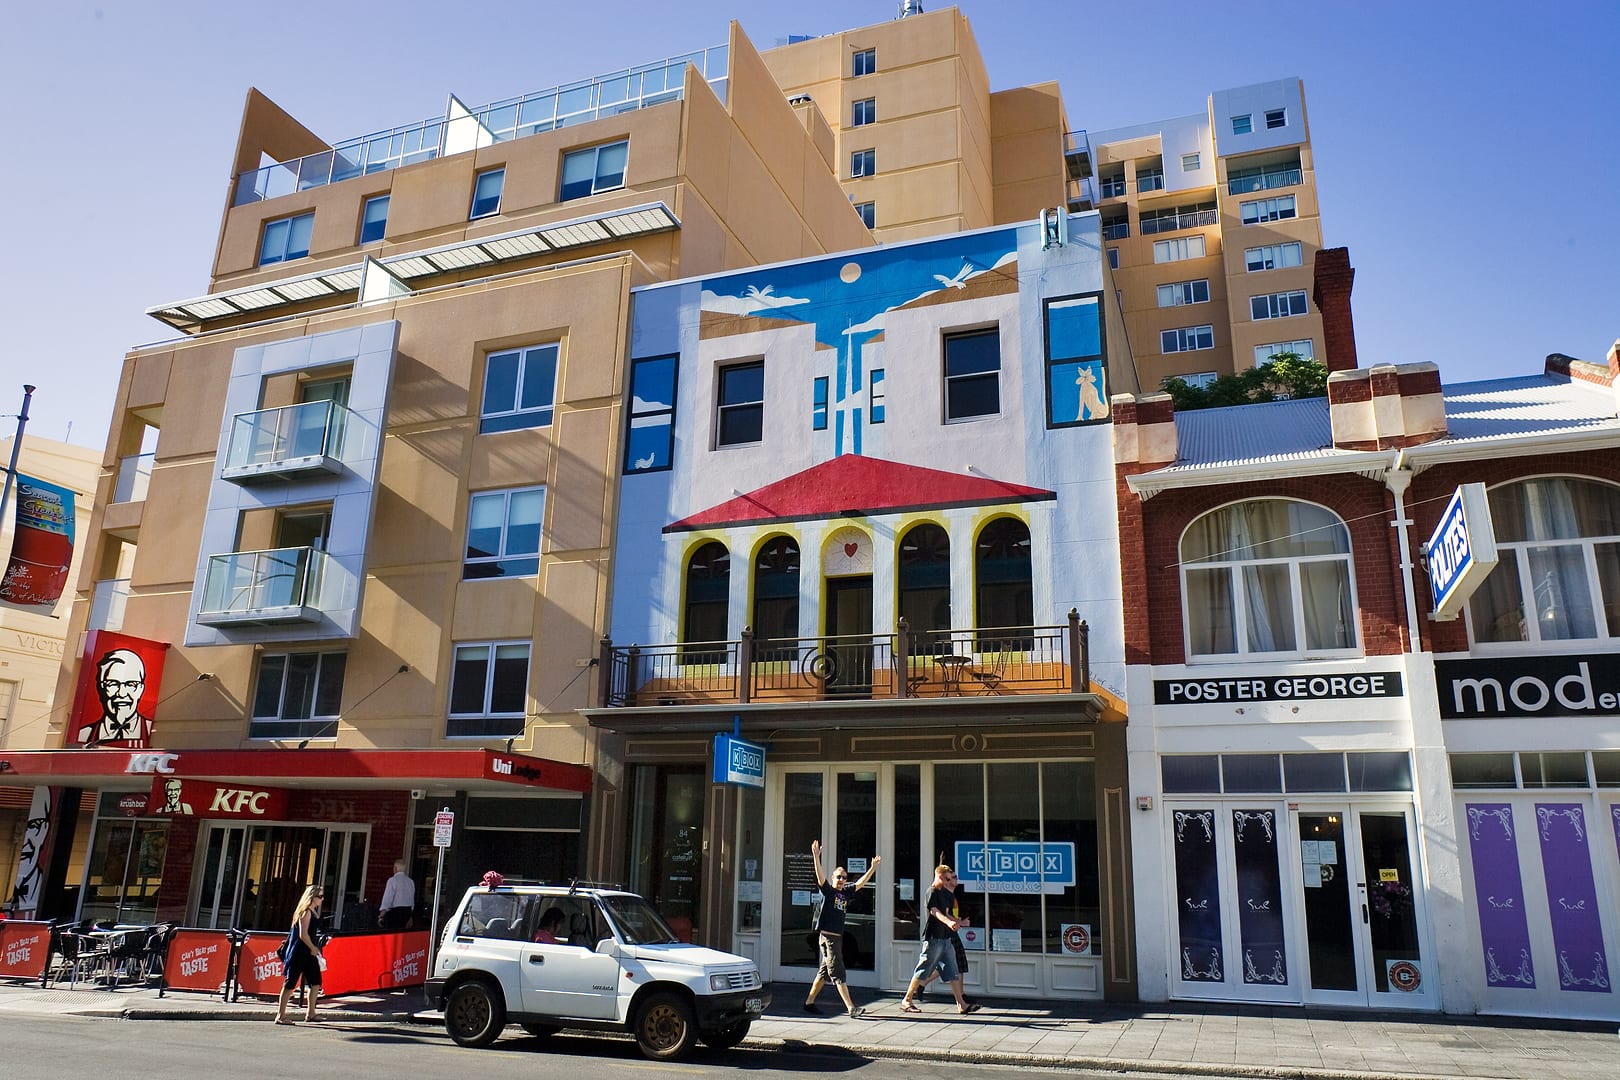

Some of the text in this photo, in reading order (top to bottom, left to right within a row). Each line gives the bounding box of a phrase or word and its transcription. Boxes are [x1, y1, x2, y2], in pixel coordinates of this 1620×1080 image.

[1430, 508, 1468, 599] POLITES
[1169, 676, 1386, 701] POSTER GEORGE
[124, 753, 179, 773] KFC
[209, 788, 270, 814] KFC
[1186, 898, 1208, 909] Sue
[1248, 899, 1270, 910] Sue
[1488, 896, 1513, 908] Sue
[1559, 898, 1585, 910] Sue
[7, 947, 31, 965] TASTE
[181, 957, 208, 976] TASTE
[254, 961, 282, 980] TASTE
[393, 962, 418, 982] TASTE
